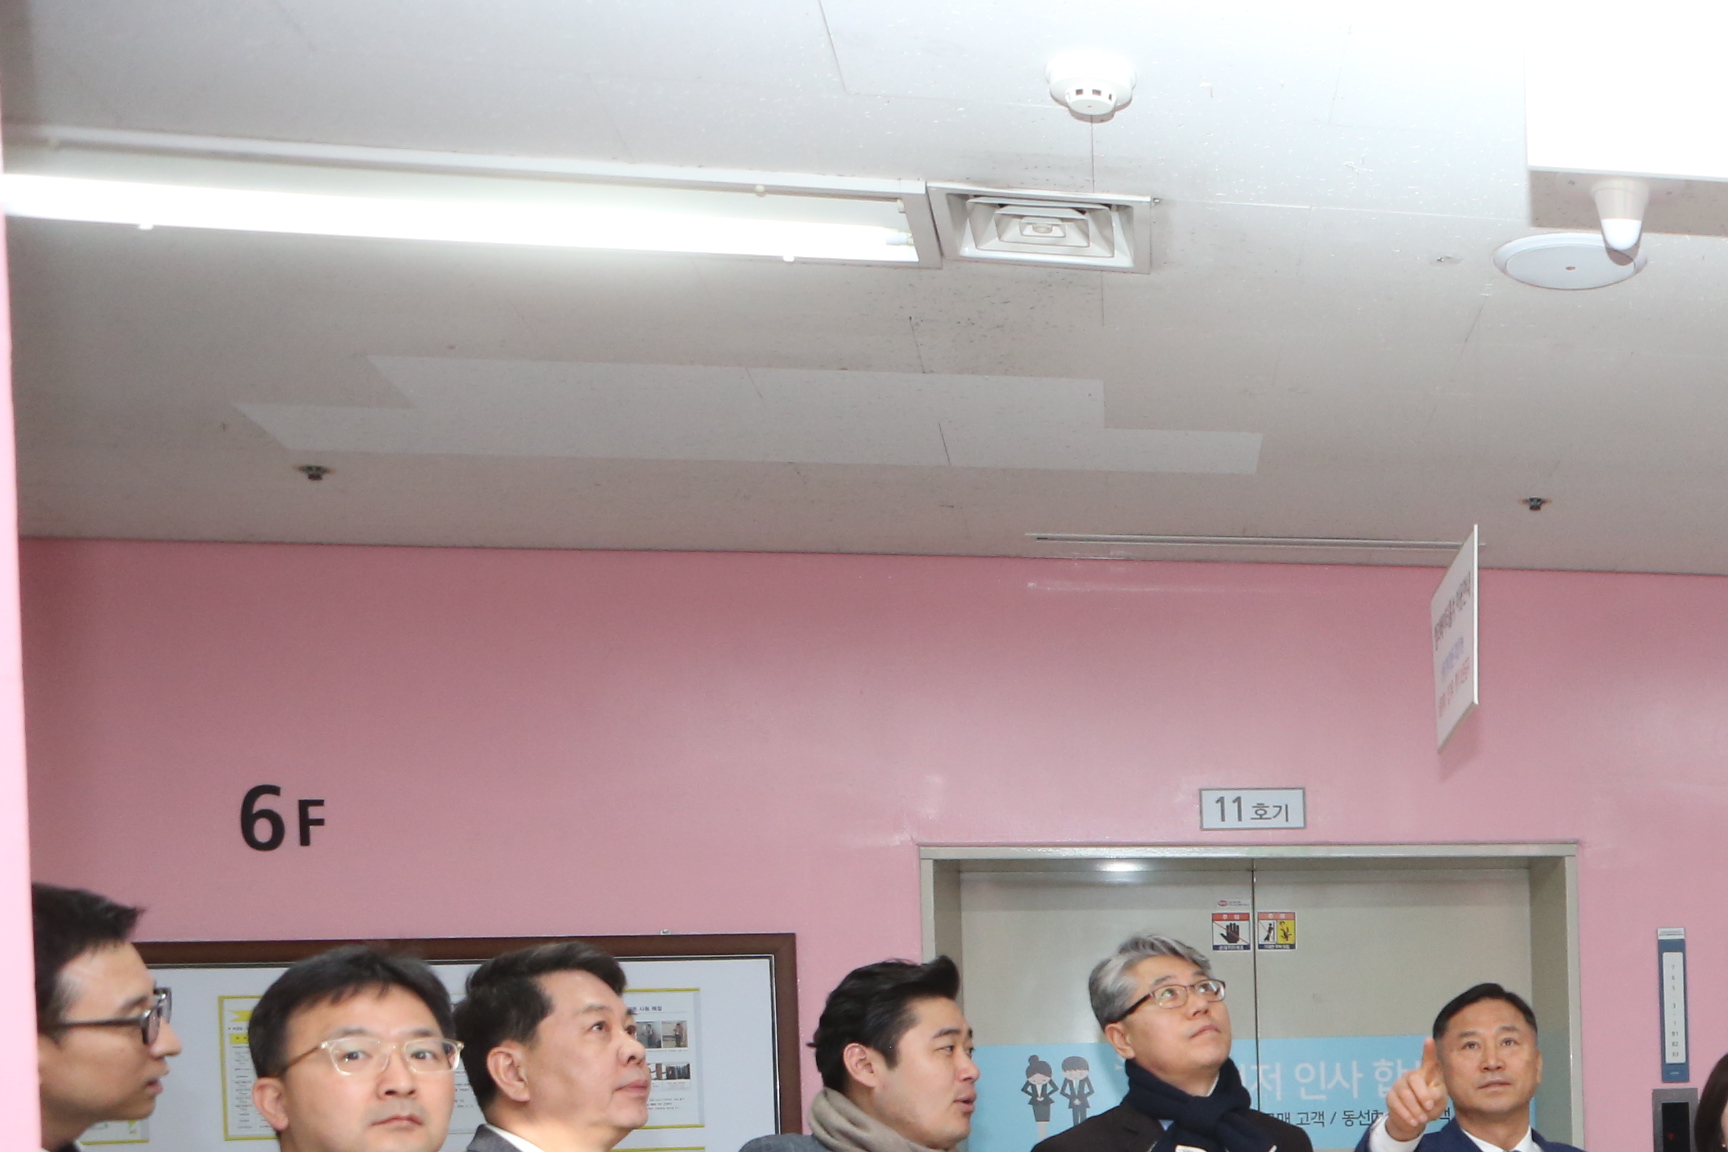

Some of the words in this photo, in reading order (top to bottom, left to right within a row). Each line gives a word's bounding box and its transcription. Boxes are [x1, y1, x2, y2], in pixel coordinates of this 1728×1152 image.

[240, 783, 326, 852] 6F
[1294, 1060, 1364, 1100] 인사
[1296, 1110, 1326, 1128] 고객
